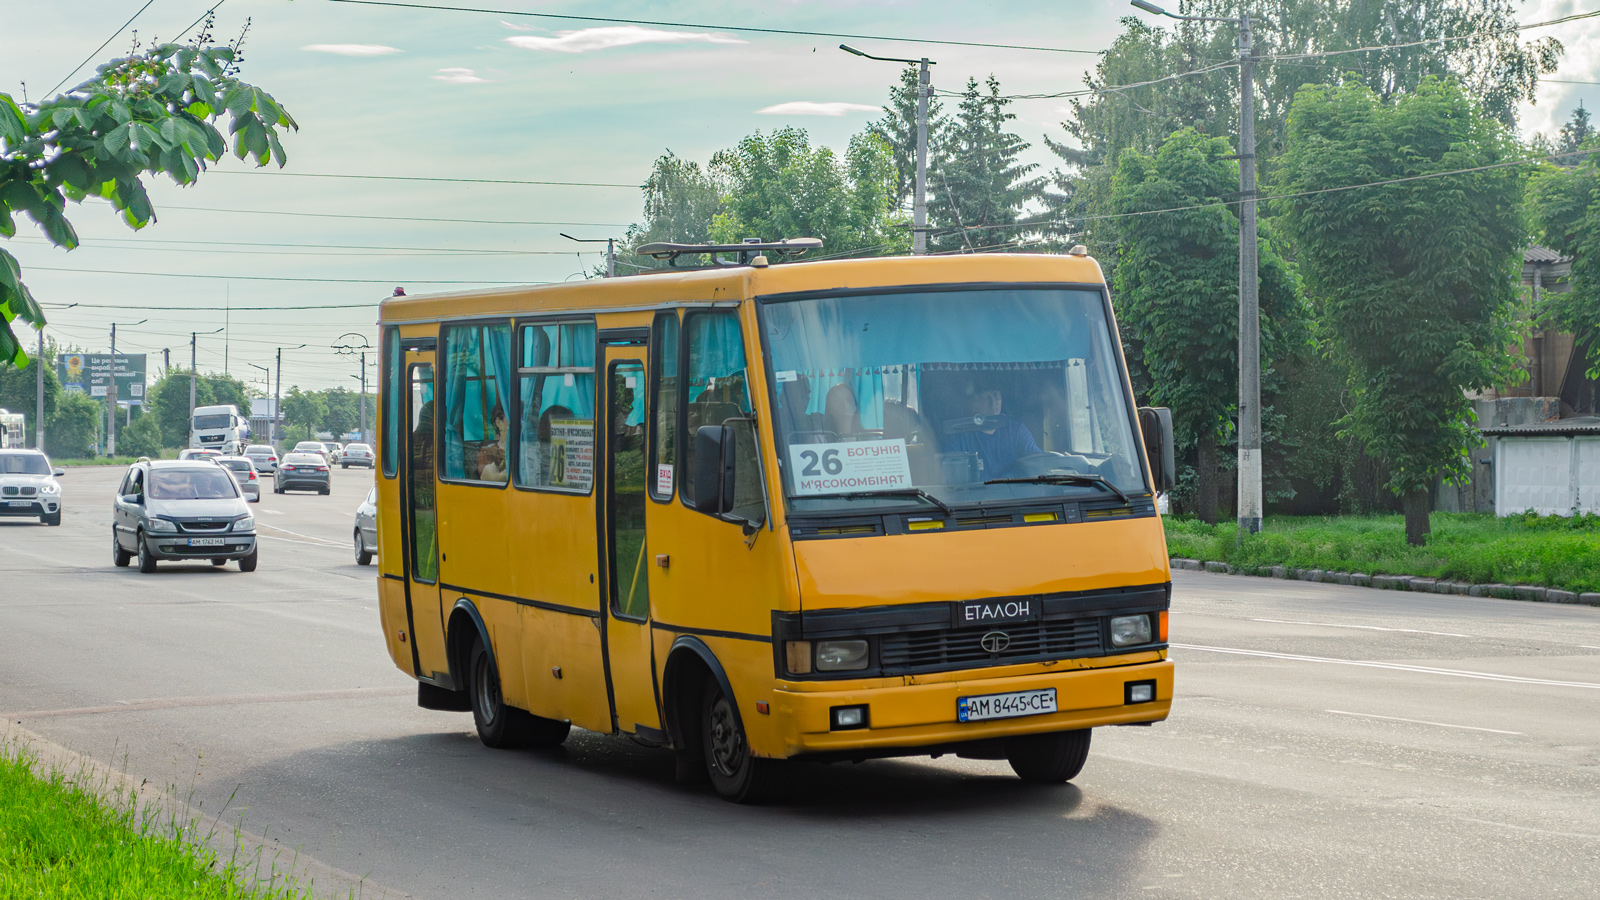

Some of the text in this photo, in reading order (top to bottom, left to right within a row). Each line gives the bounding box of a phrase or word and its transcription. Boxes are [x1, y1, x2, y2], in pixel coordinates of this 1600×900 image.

[550, 445, 565, 483] 26
[800, 445, 901, 477] 26 БОГУНІЯ
[660, 469, 671, 480] ВХІД
[800, 475, 904, 490] М'ЯСОКОМБІНАТ
[965, 601, 1030, 620] ЕТАЛОН
[970, 693, 1050, 716] AM 8445 CE
